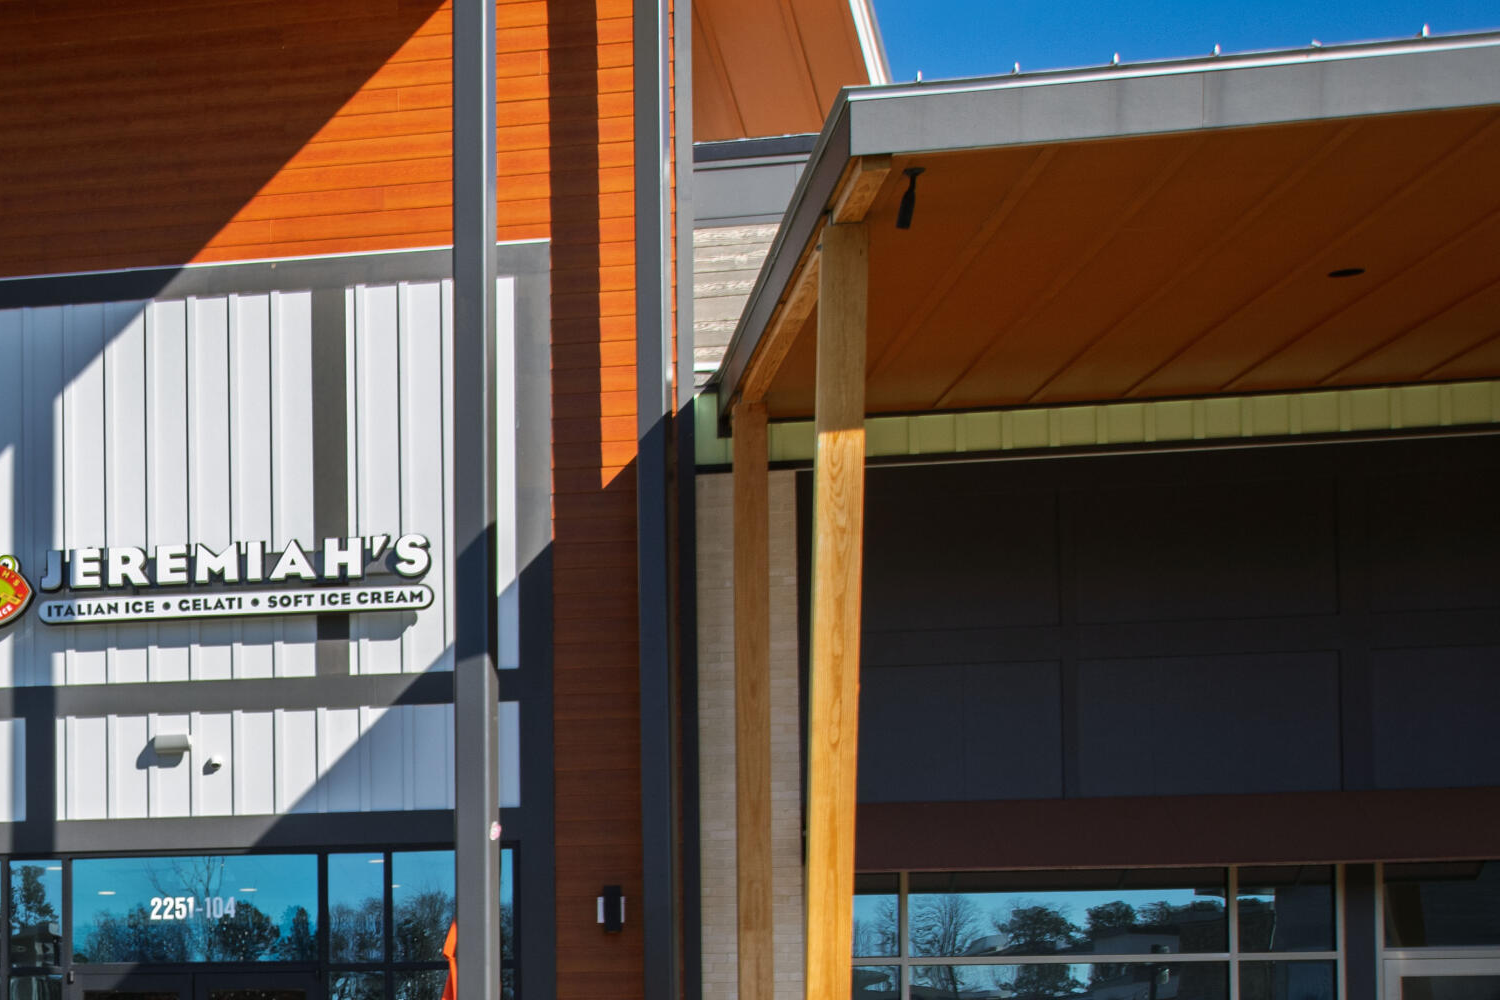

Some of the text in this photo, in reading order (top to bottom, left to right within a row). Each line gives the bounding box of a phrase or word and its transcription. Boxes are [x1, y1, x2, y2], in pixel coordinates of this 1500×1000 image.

[41, 533, 431, 591] JEREMIAH'S
[47, 590, 424, 618] ITALIAN ICE GELATI SOFT ICE CREAM
[150, 896, 236, 920] 2251-104
